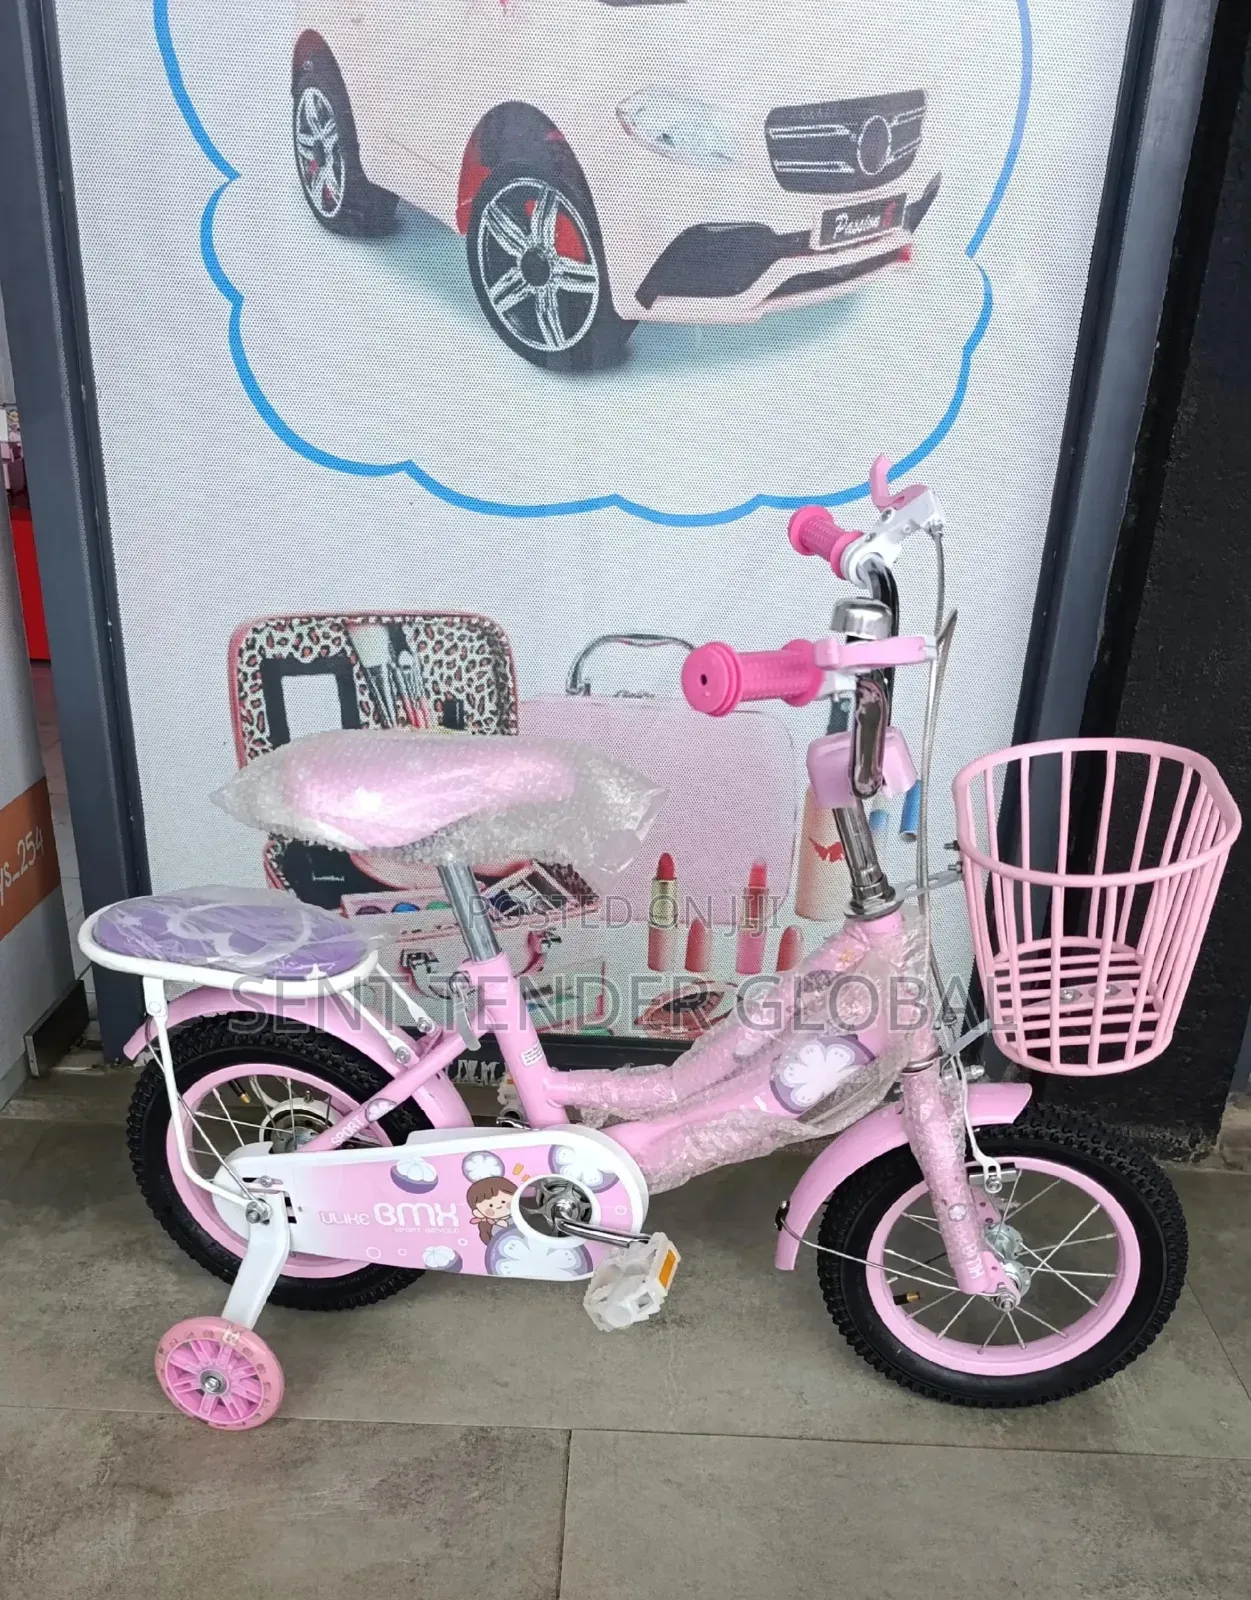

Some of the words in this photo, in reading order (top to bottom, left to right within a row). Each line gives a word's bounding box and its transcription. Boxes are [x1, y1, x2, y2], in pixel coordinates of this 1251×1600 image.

[331, 1115, 365, 1146] SPORT
[319, 1210, 371, 1226] ULIKE
[373, 1202, 459, 1228] BMX
